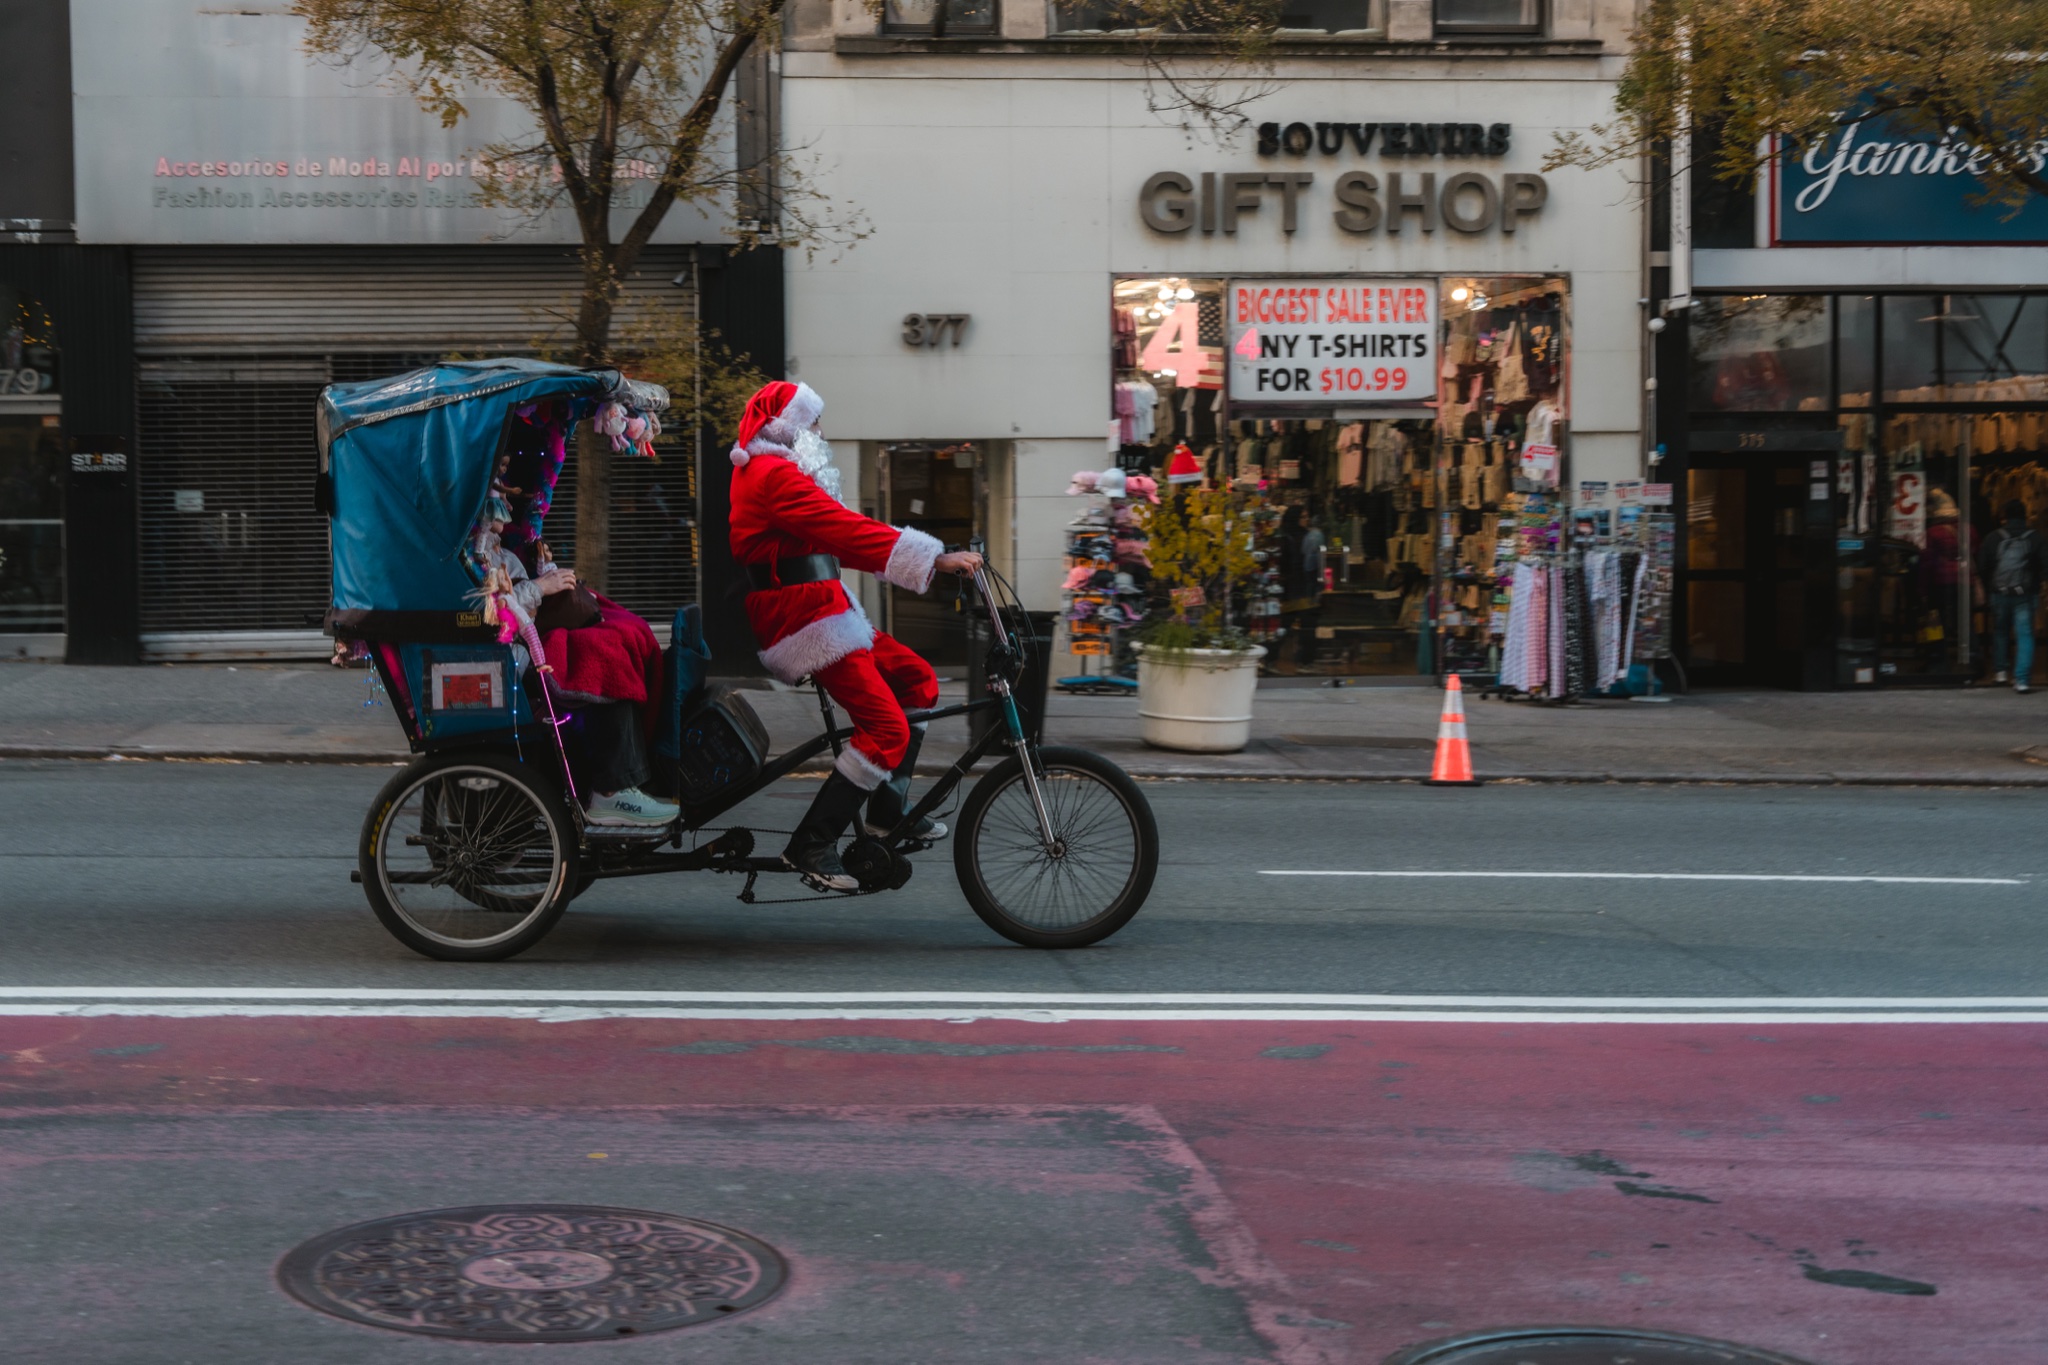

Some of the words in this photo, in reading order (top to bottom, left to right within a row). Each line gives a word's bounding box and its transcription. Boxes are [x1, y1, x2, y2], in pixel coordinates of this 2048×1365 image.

[1257, 122, 1511, 156] SOUVENIRS
[154, 157, 289, 177] Accesorios
[295, 157, 322, 177] de
[328, 157, 391, 177] Moda
[396, 157, 421, 177] Al
[426, 160, 465, 183] por
[1795, 111, 2048, 213] Yankes
[153, 187, 253, 208] Fashion
[259, 187, 418, 208] Accessories
[425, 187, 497, 209] Reta
[1140, 171, 1313, 233] GIFT
[1334, 171, 1548, 233] SHOP
[1236, 287, 1319, 324] BIGGEST
[1327, 288, 1371, 323] SALE
[1378, 287, 1429, 323] EVER
[902, 313, 971, 347] 377
[1142, 302, 1209, 388] 4
[1309, 334, 1427, 358] T-SHIRTS
[1257, 368, 1311, 392] FOR
[1319, 366, 1408, 394] $10.99
[615, 800, 642, 813] HOKA
